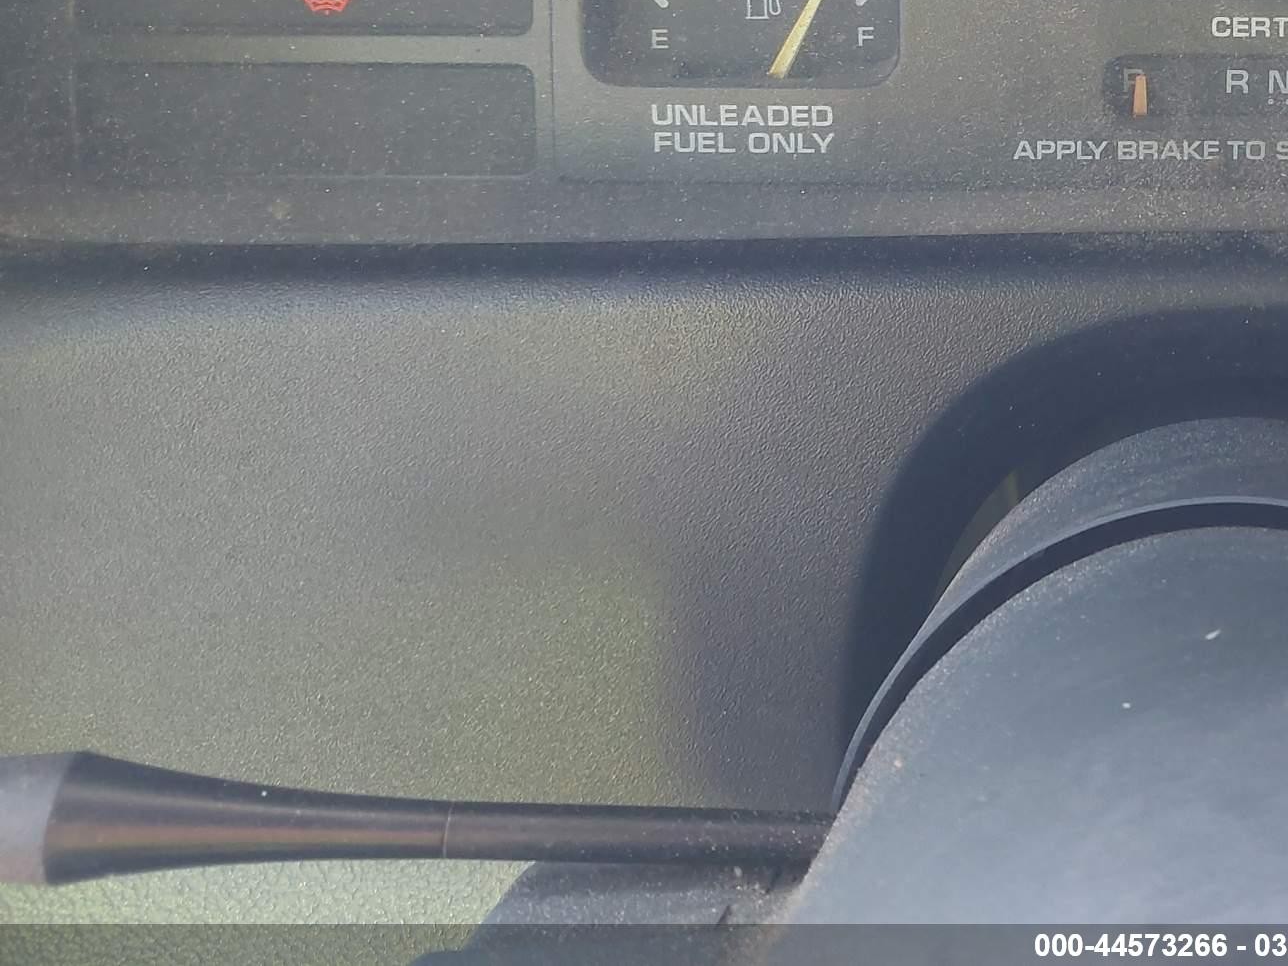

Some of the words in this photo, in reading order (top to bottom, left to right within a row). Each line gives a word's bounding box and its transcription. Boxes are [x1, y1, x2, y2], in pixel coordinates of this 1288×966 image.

[652, 29, 669, 49] E
[857, 27, 875, 47] F
[1225, 69, 1249, 94] R
[651, 104, 834, 127] UNLEADED
[653, 131, 737, 154] FUEL
[748, 131, 835, 154] ONLY
[1013, 140, 1108, 161] APPLY
[1117, 140, 1219, 161] BRAKE
[1227, 140, 1266, 161] TO
